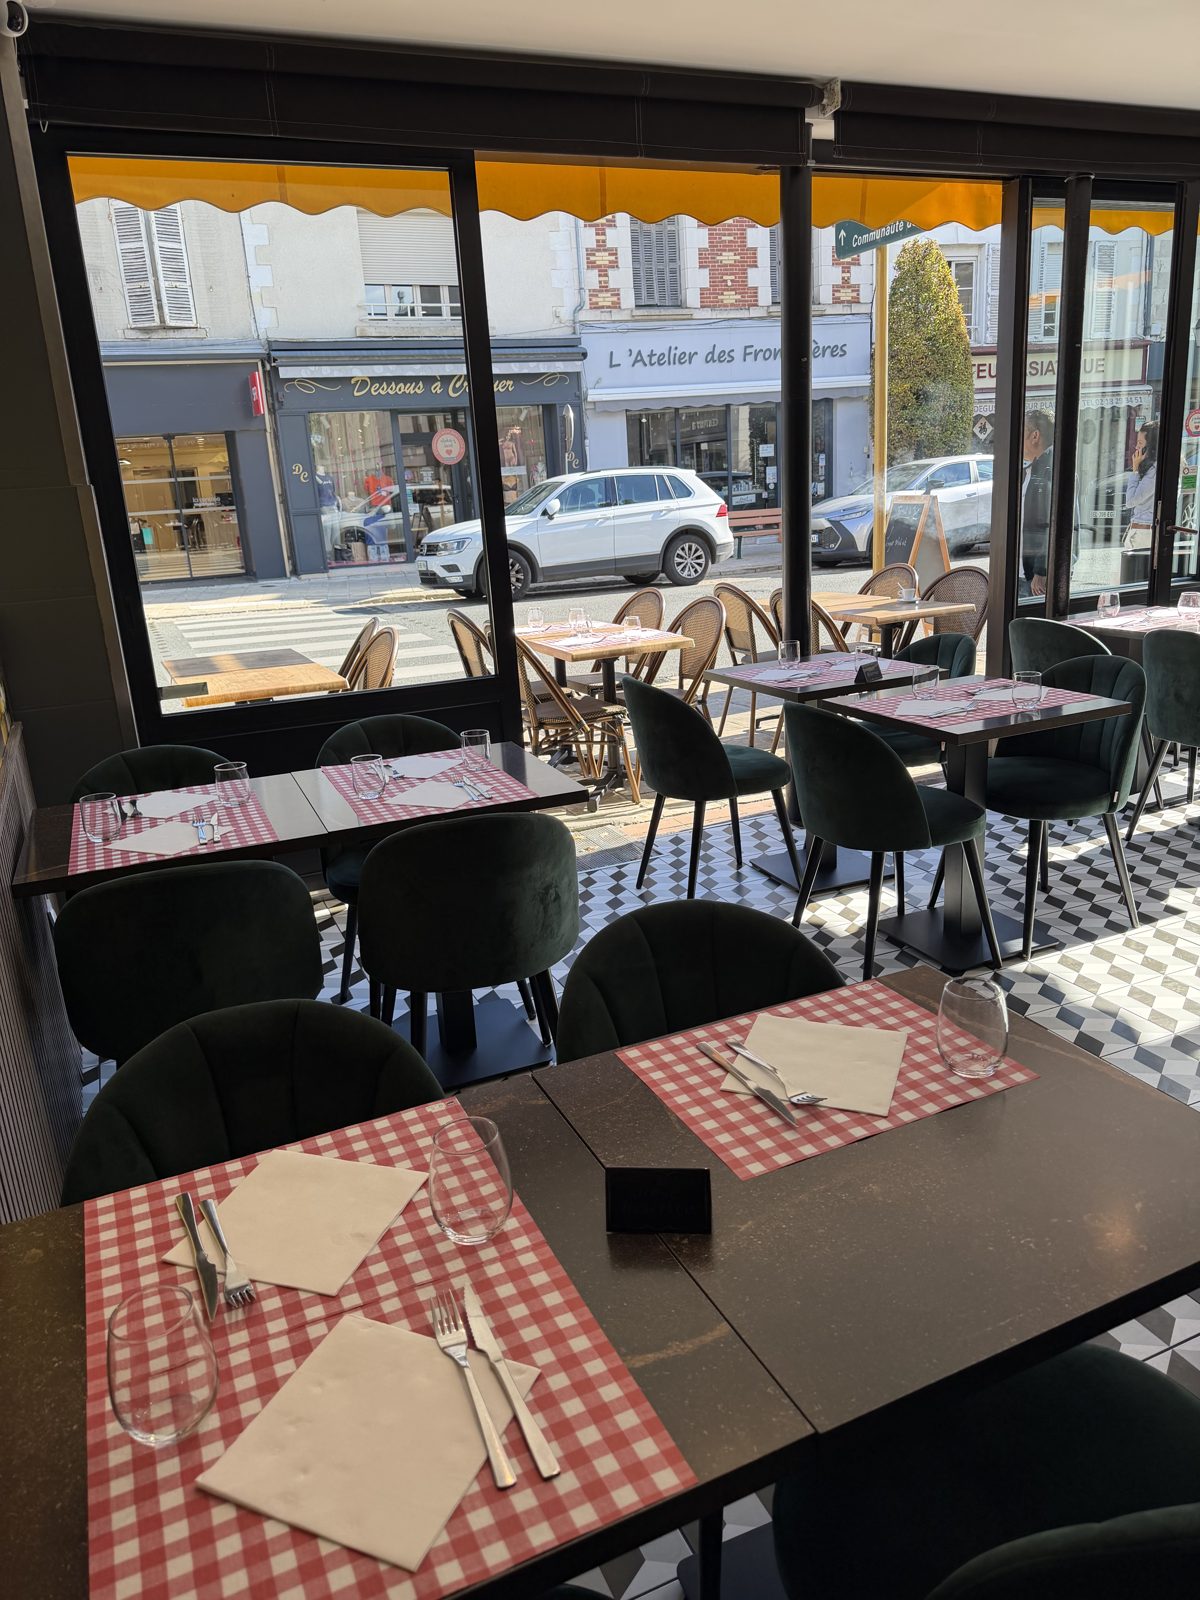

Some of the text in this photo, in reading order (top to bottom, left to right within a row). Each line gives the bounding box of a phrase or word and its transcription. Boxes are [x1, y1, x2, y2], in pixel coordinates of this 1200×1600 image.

[704, 344, 736, 364] des
[351, 375, 425, 397] Dessous
[431, 375, 444, 394] à
